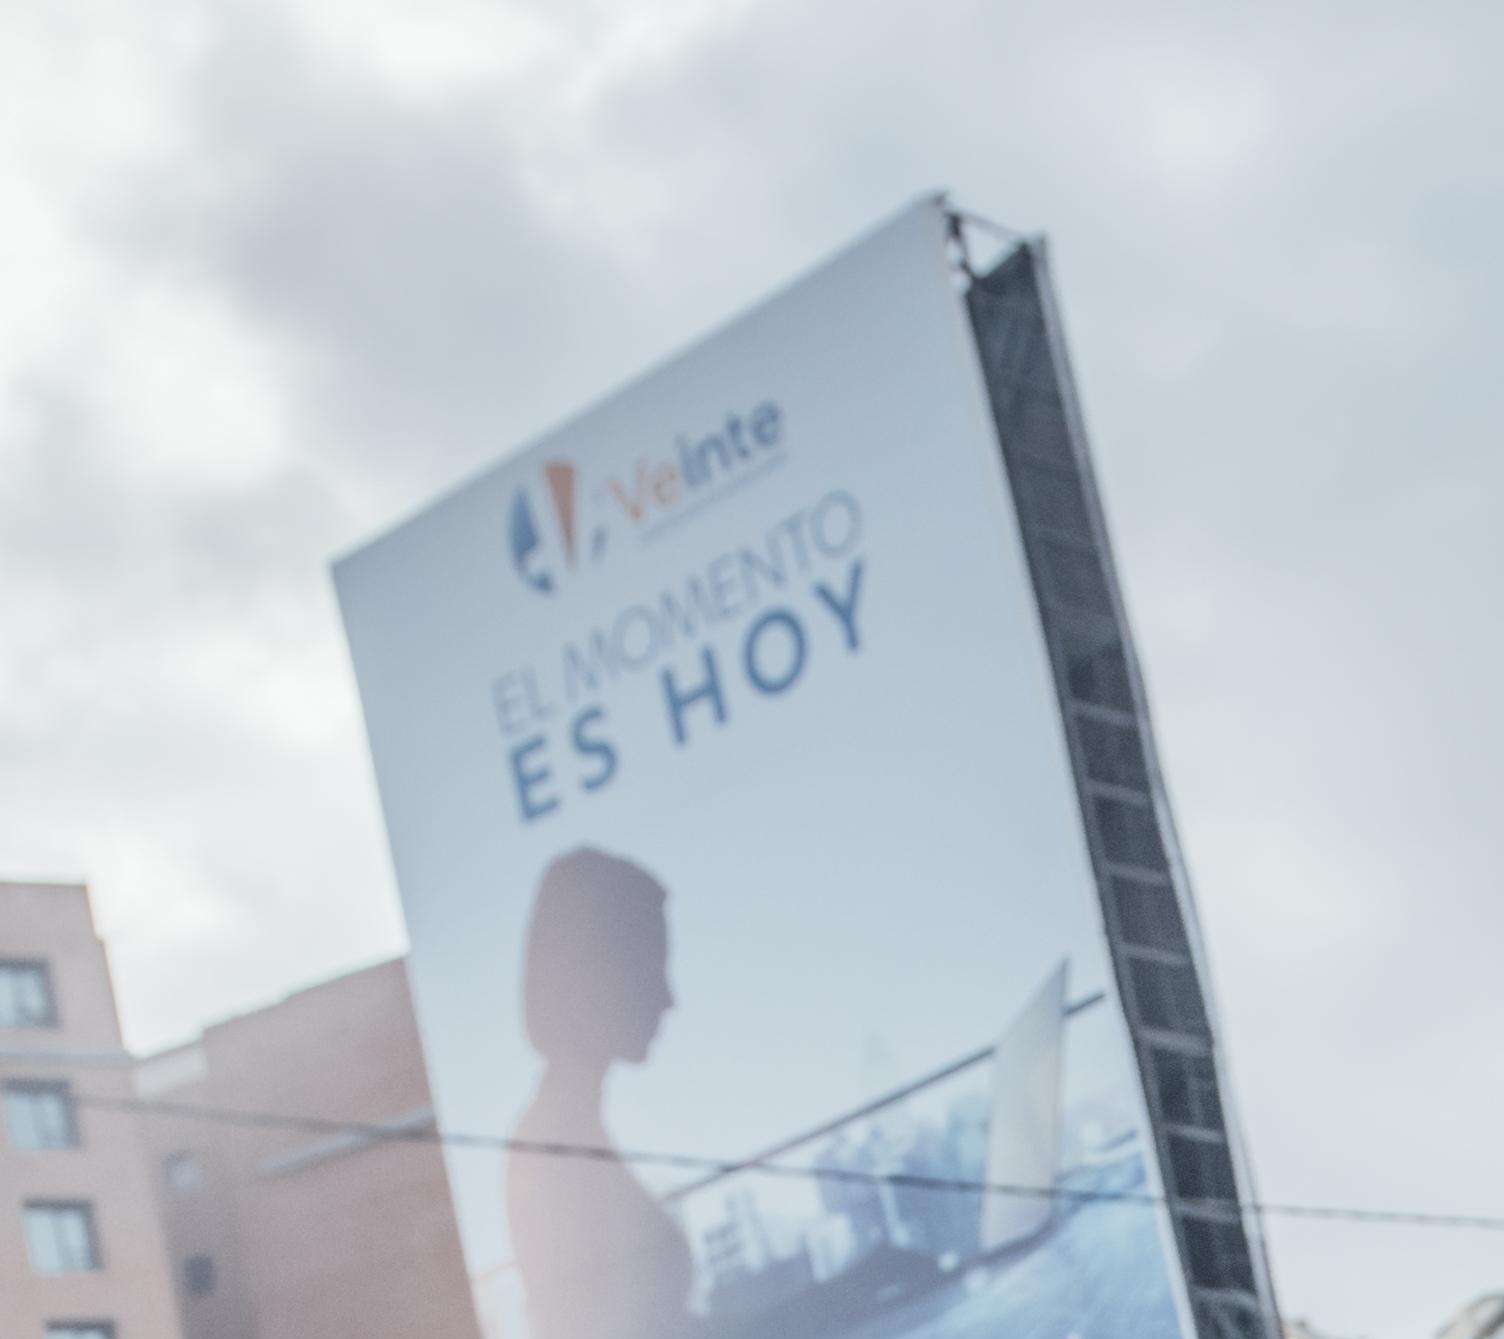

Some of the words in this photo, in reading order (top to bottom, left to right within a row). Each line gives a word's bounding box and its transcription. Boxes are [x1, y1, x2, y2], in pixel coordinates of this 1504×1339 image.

[510, 704, 620, 824] ES
[660, 555, 868, 746] HOY
[563, 490, 865, 702] MOMENTO
